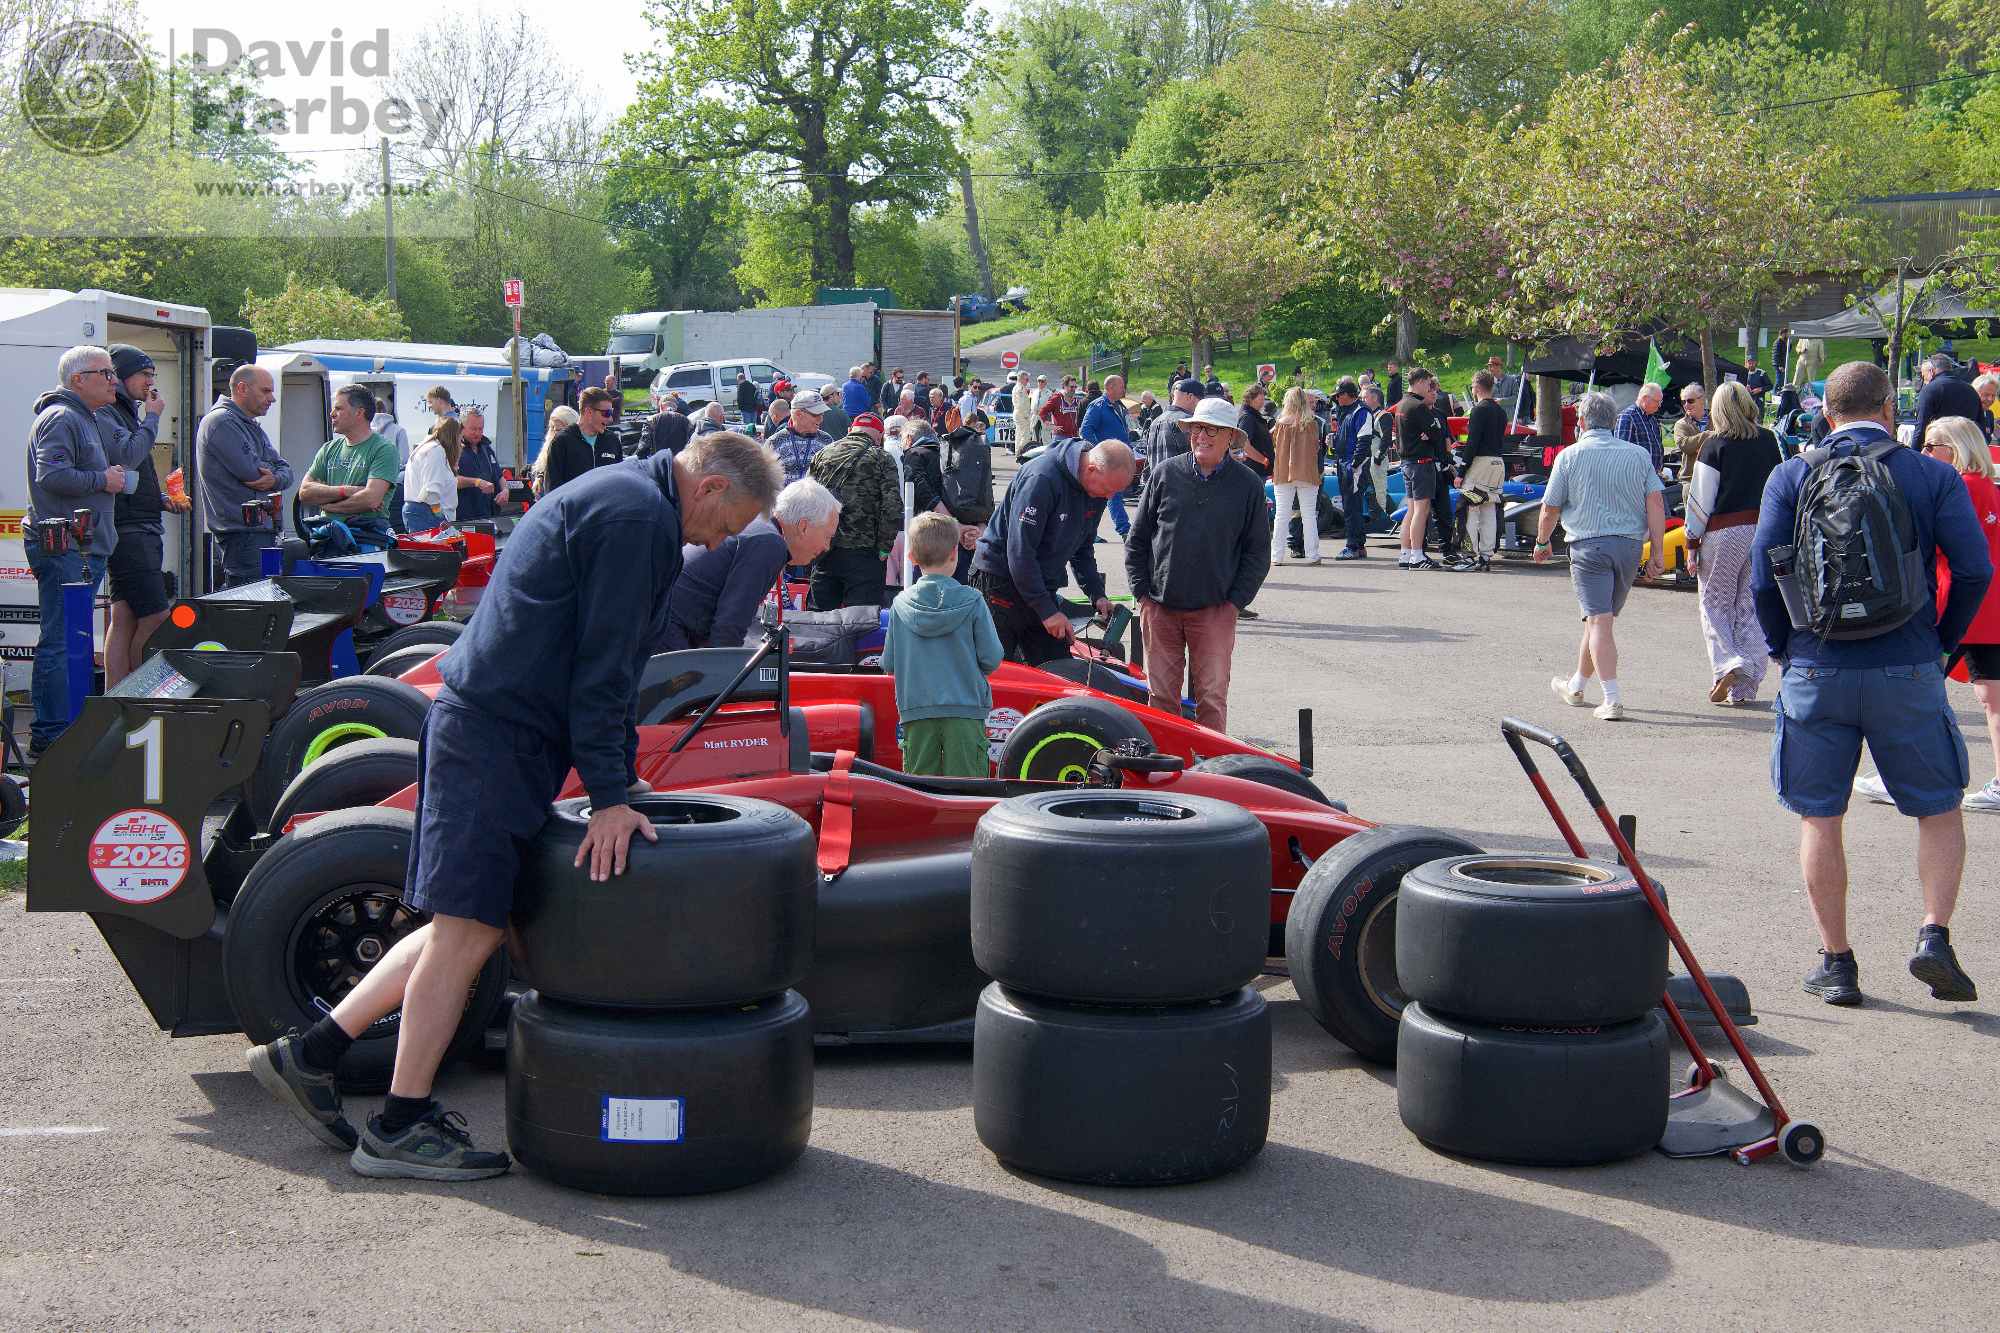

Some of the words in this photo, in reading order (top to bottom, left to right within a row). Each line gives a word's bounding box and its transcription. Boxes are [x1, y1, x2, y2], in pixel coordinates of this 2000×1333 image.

[998, 428, 1016, 440] 178
[392, 598, 426, 609] 2026
[760, 668, 777, 681] TOW
[308, 699, 369, 722] AVON
[988, 728, 1011, 738] 20
[704, 741, 728, 749] Matt
[730, 737, 769, 748] RYDER
[126, 716, 163, 804] 1
[128, 824, 168, 834] BHC
[109, 845, 187, 867] 2026
[140, 878, 169, 886] BMTR
[1328, 874, 1373, 960] AVON
